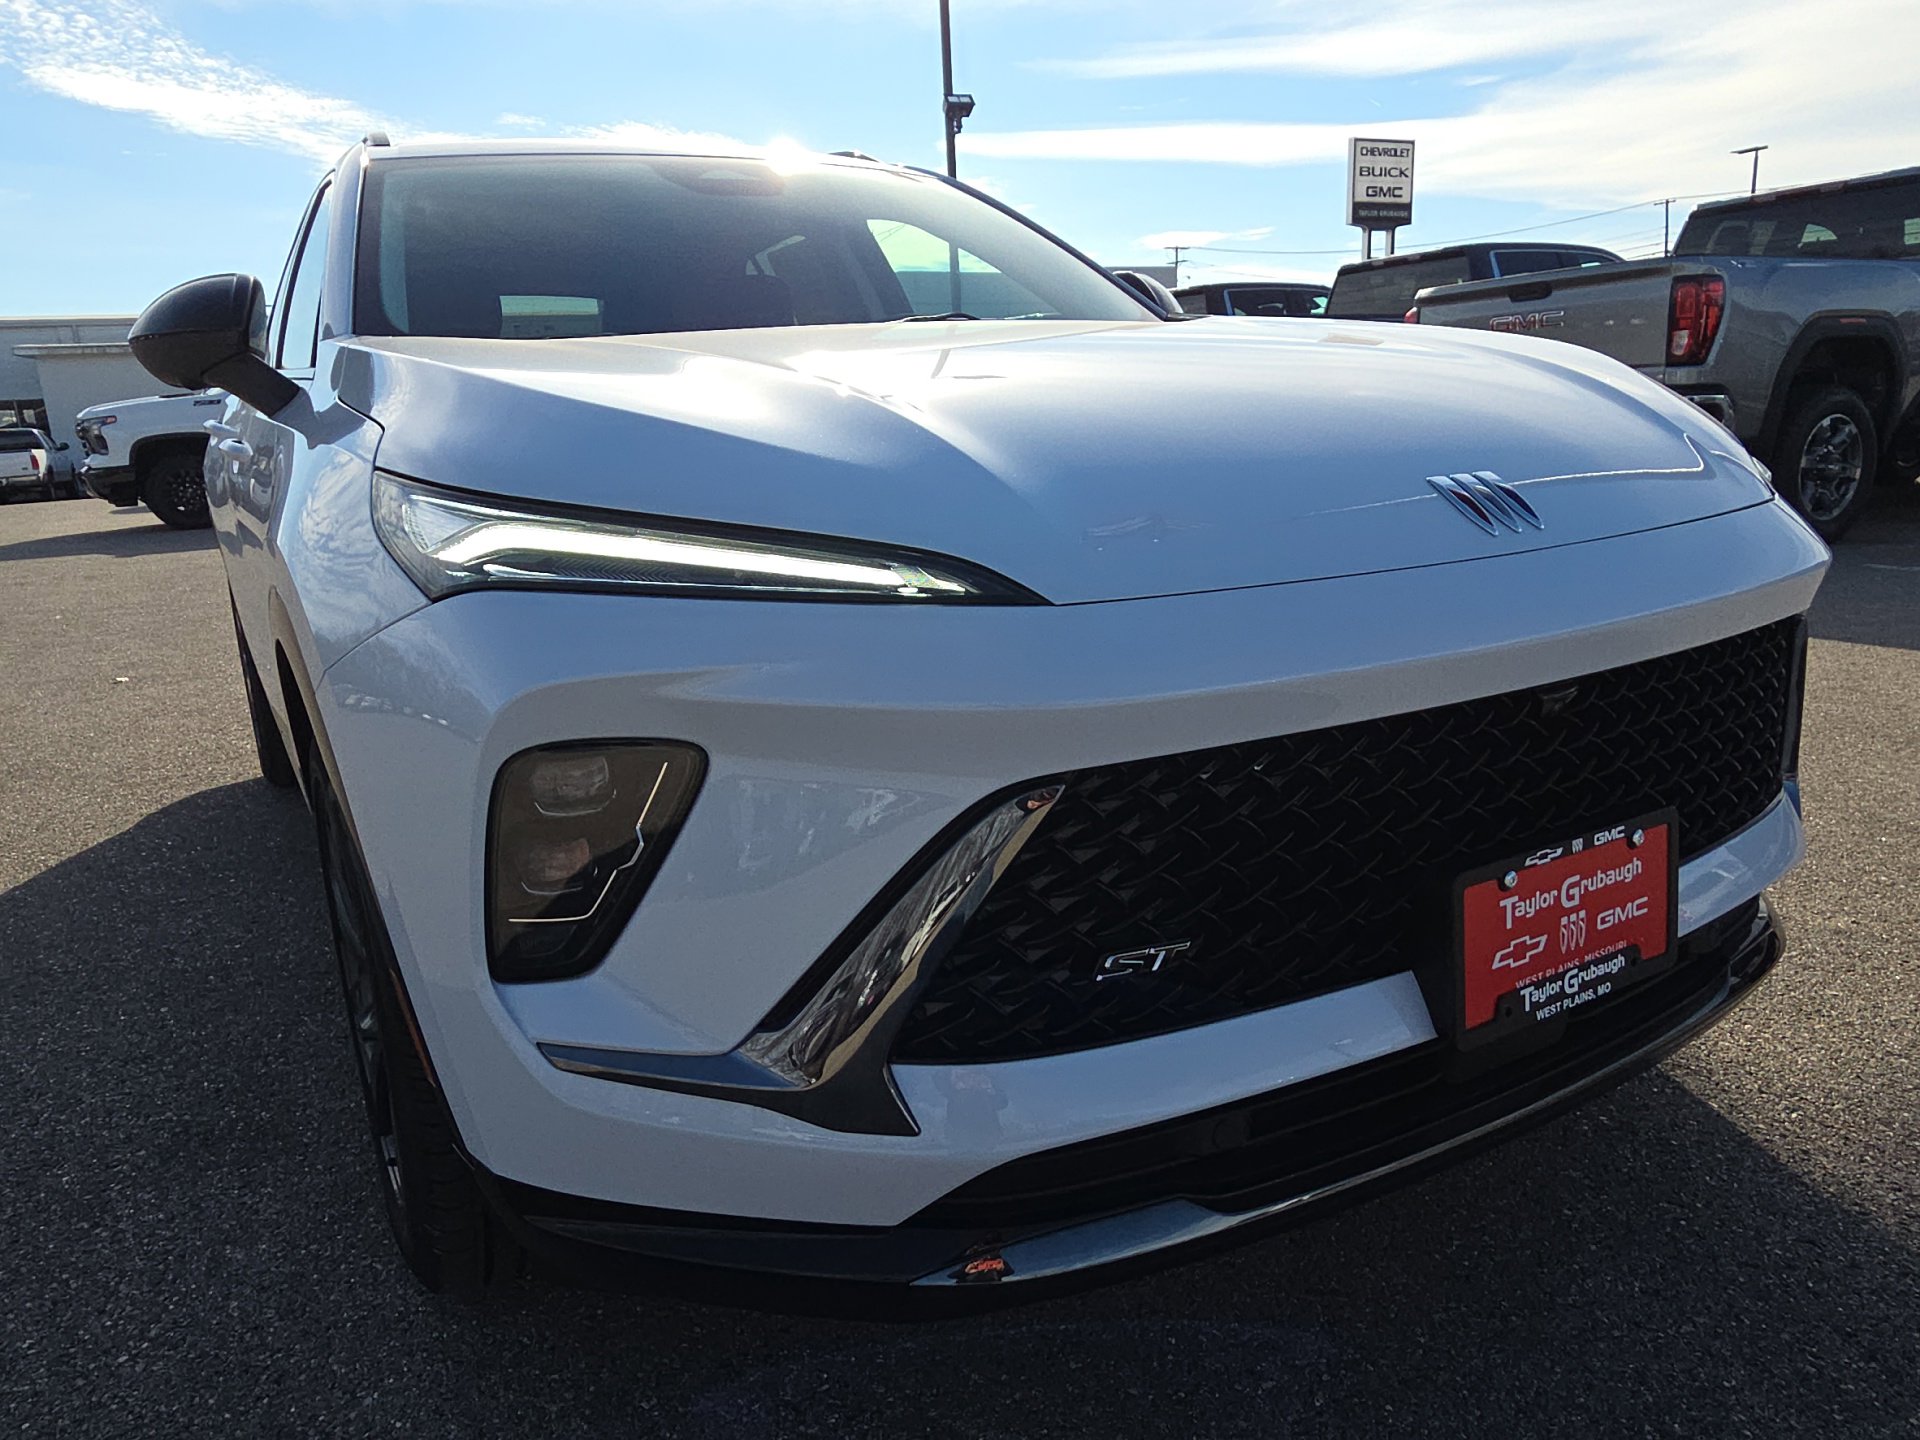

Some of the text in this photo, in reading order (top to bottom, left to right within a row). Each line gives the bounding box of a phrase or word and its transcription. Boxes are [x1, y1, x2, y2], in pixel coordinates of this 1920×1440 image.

[1360, 146, 1410, 158] CHEVROLET
[1359, 165, 1409, 178] BUICK
[1366, 185, 1403, 198] GMC
[1489, 310, 1564, 332] GMC
[1594, 825, 1626, 846] GMC
[1499, 857, 1643, 930] Taylor Grubaugh
[1596, 896, 1649, 930] GMC
[1096, 941, 1191, 982] ST
[1520, 953, 1626, 1012] Taylor Grubaugh
[1536, 1001, 1562, 1021] WEST
[1597, 981, 1612, 997] MO
